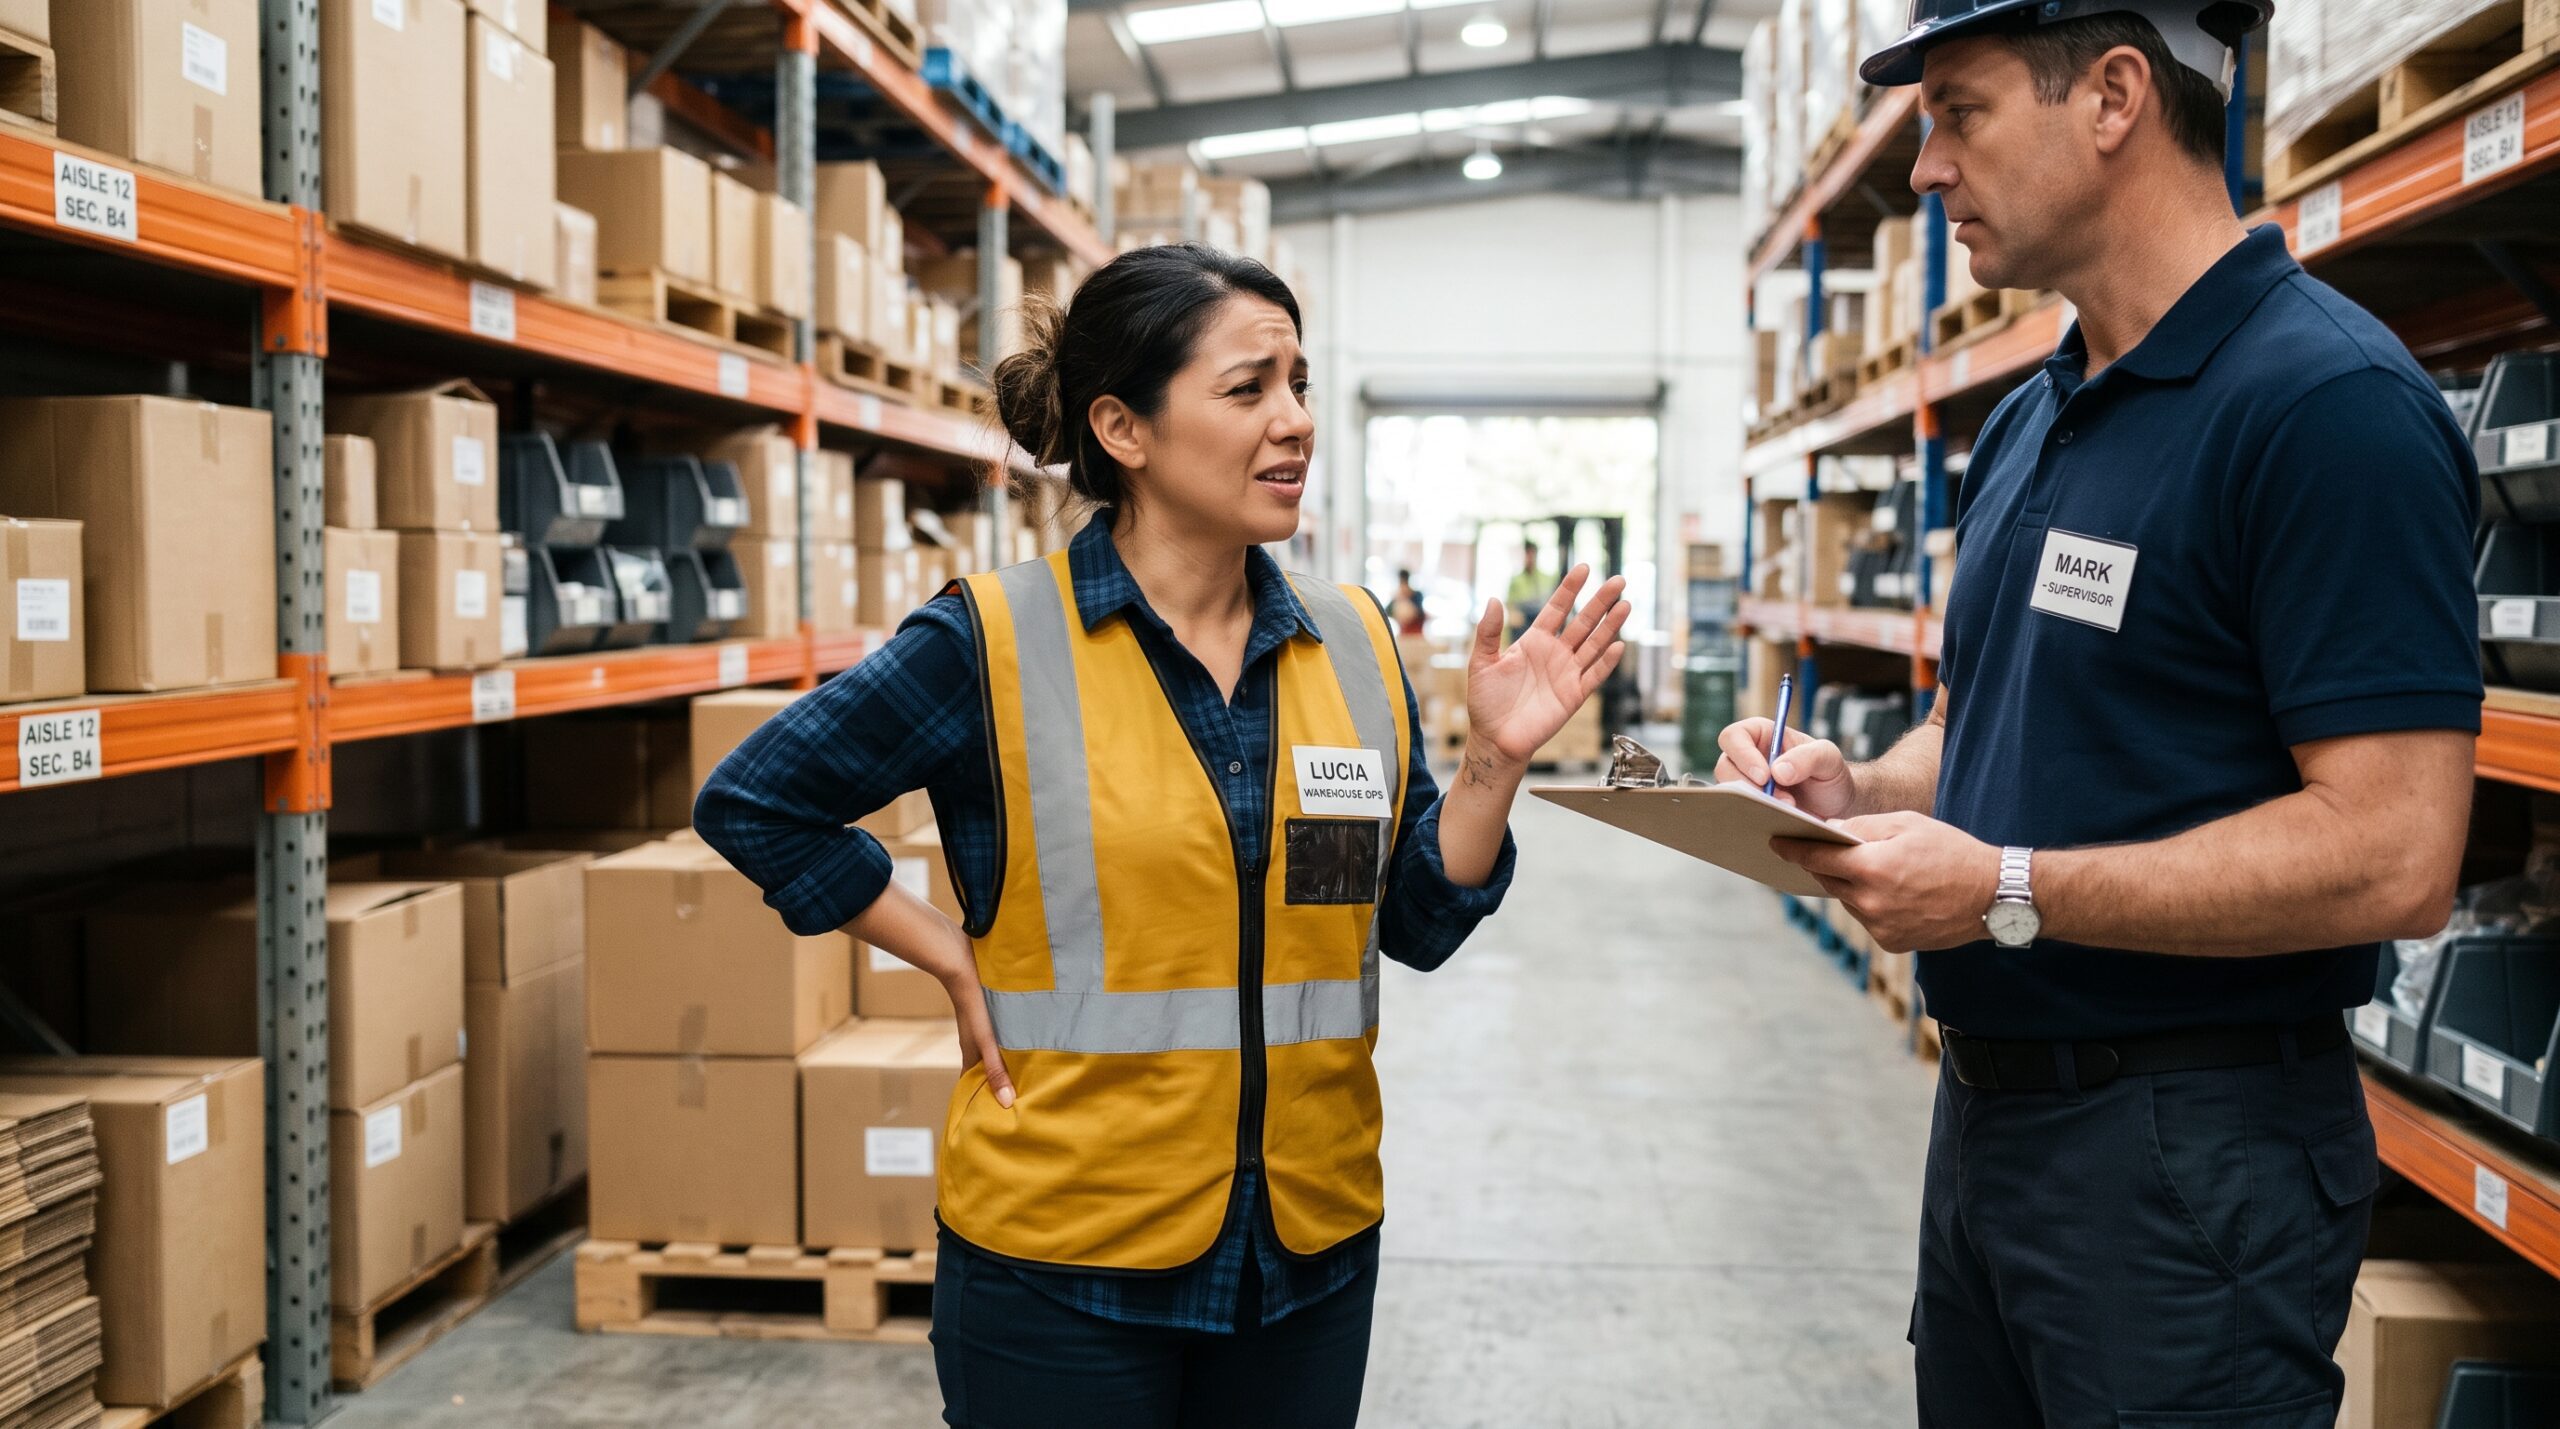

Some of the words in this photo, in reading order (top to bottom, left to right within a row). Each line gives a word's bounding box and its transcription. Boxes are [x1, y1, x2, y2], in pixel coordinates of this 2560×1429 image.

[61, 163, 107, 194] AISLE
[114, 178, 130, 200] 12
[65, 196, 102, 224] SEC.
[106, 206, 126, 228] B4
[2055, 553, 2113, 584] MARK
[25, 719, 73, 745] AISLE
[79, 718, 95, 739] 12
[29, 753, 67, 777] SEC.
[73, 750, 93, 770] B4
[1310, 761, 1369, 782] LUCIA
[1365, 790, 1384, 800] OPS
